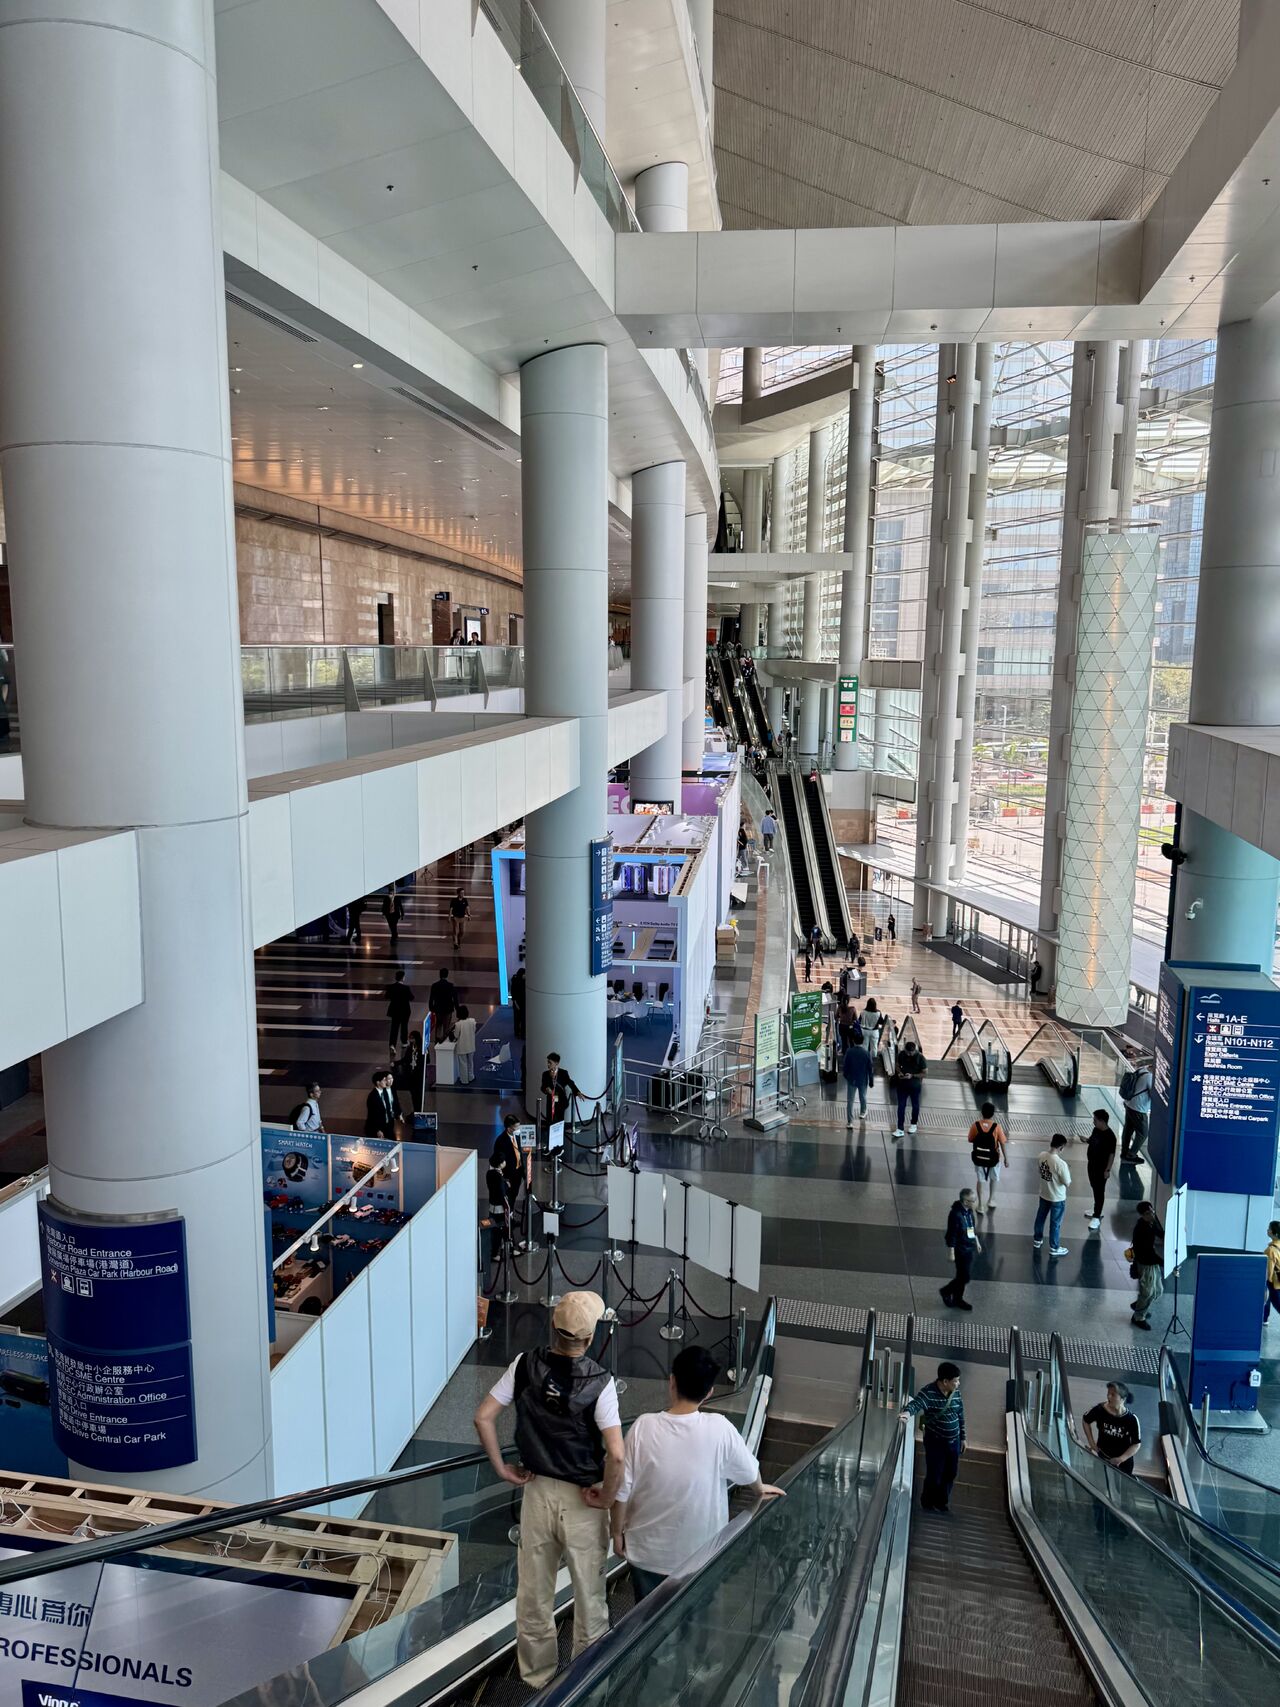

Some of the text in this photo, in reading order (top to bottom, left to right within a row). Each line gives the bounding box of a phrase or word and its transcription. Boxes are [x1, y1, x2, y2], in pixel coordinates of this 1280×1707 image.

[1225, 1015, 1248, 1024] 1A-E
[1224, 1037, 1274, 1048] N101-N112
[278, 1139, 312, 1148] SMART WATCH
[68, 1244, 88, 1256] Road
[90, 1248, 132, 1258] Entrance
[71, 1265, 87, 1276] Plaza
[88, 1269, 100, 1278] Car
[101, 1270, 119, 1278] Park
[120, 1267, 153, 1278] (Harbour
[155, 1262, 179, 1274] Road)
[75, 1369, 92, 1382] SME
[95, 1374, 126, 1384] Centre
[77, 1390, 136, 1404] Administration
[138, 1392, 167, 1403] Office
[70, 1405, 88, 1419] Drive
[89, 1412, 128, 1424] Entrance
[72, 1425, 89, 1439] Drive
[90, 1432, 122, 1444] Central
[123, 1435, 142, 1444] Car
[143, 1431, 167, 1443] Park
